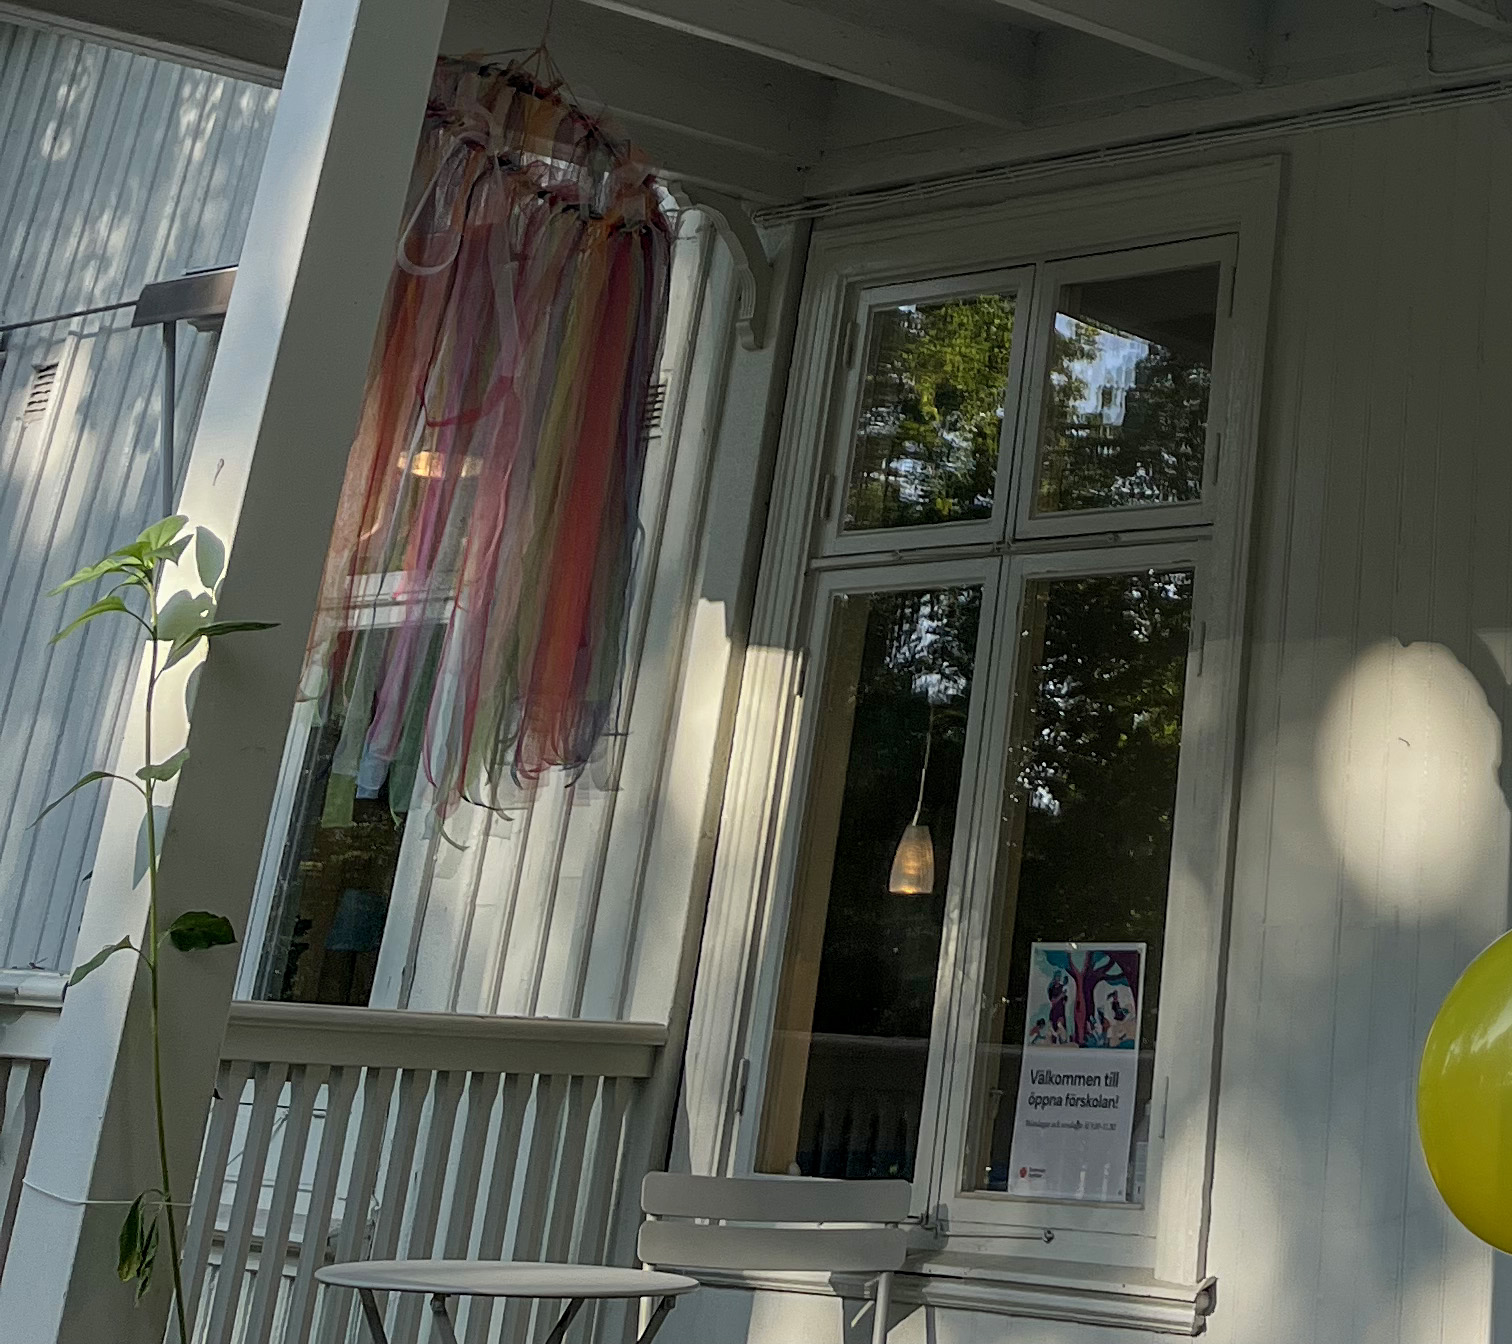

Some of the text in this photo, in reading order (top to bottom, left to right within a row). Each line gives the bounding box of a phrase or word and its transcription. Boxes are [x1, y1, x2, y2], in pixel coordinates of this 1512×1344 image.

[1030, 1069, 1120, 1088] Välkommen till
[1028, 1091, 1119, 1110] öppna förskolan!
